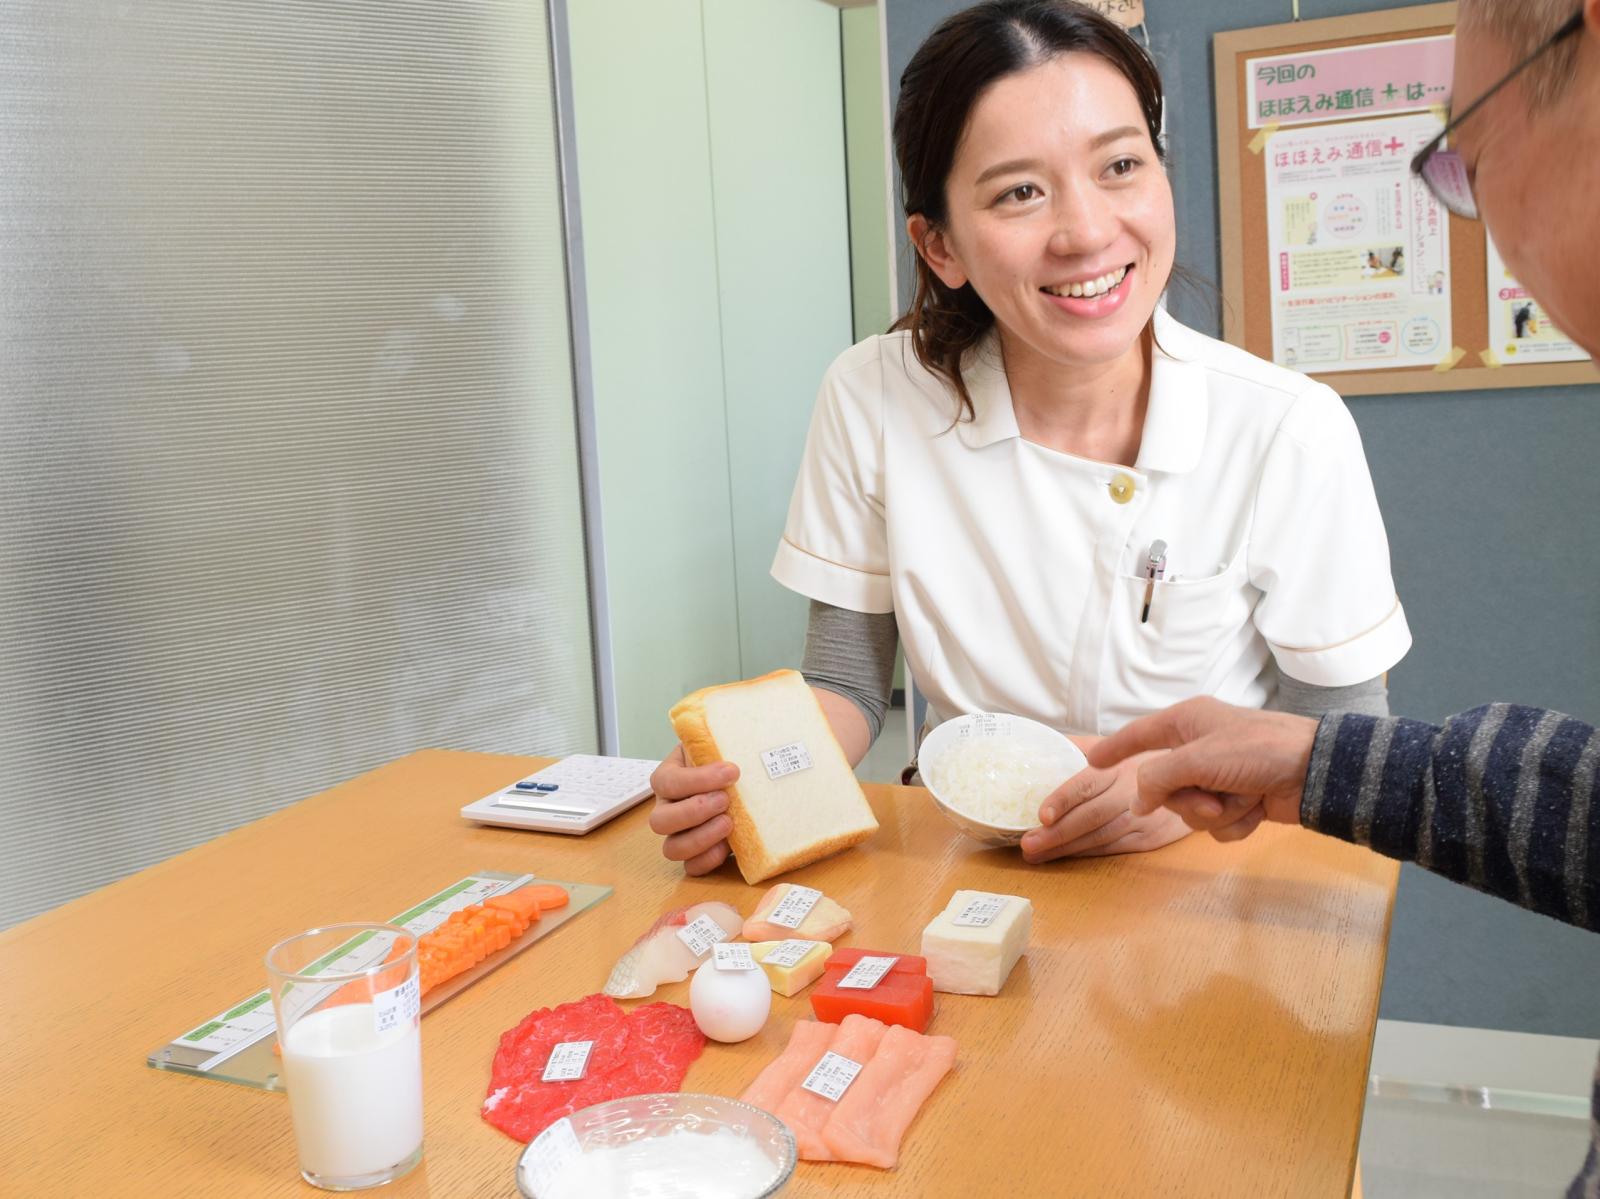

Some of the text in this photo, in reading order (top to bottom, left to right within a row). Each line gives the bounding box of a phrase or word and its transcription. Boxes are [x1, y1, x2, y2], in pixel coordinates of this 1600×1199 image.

[1257, 64, 1316, 85] 今回の
[1258, 88, 1374, 117] ほほえみ通信
